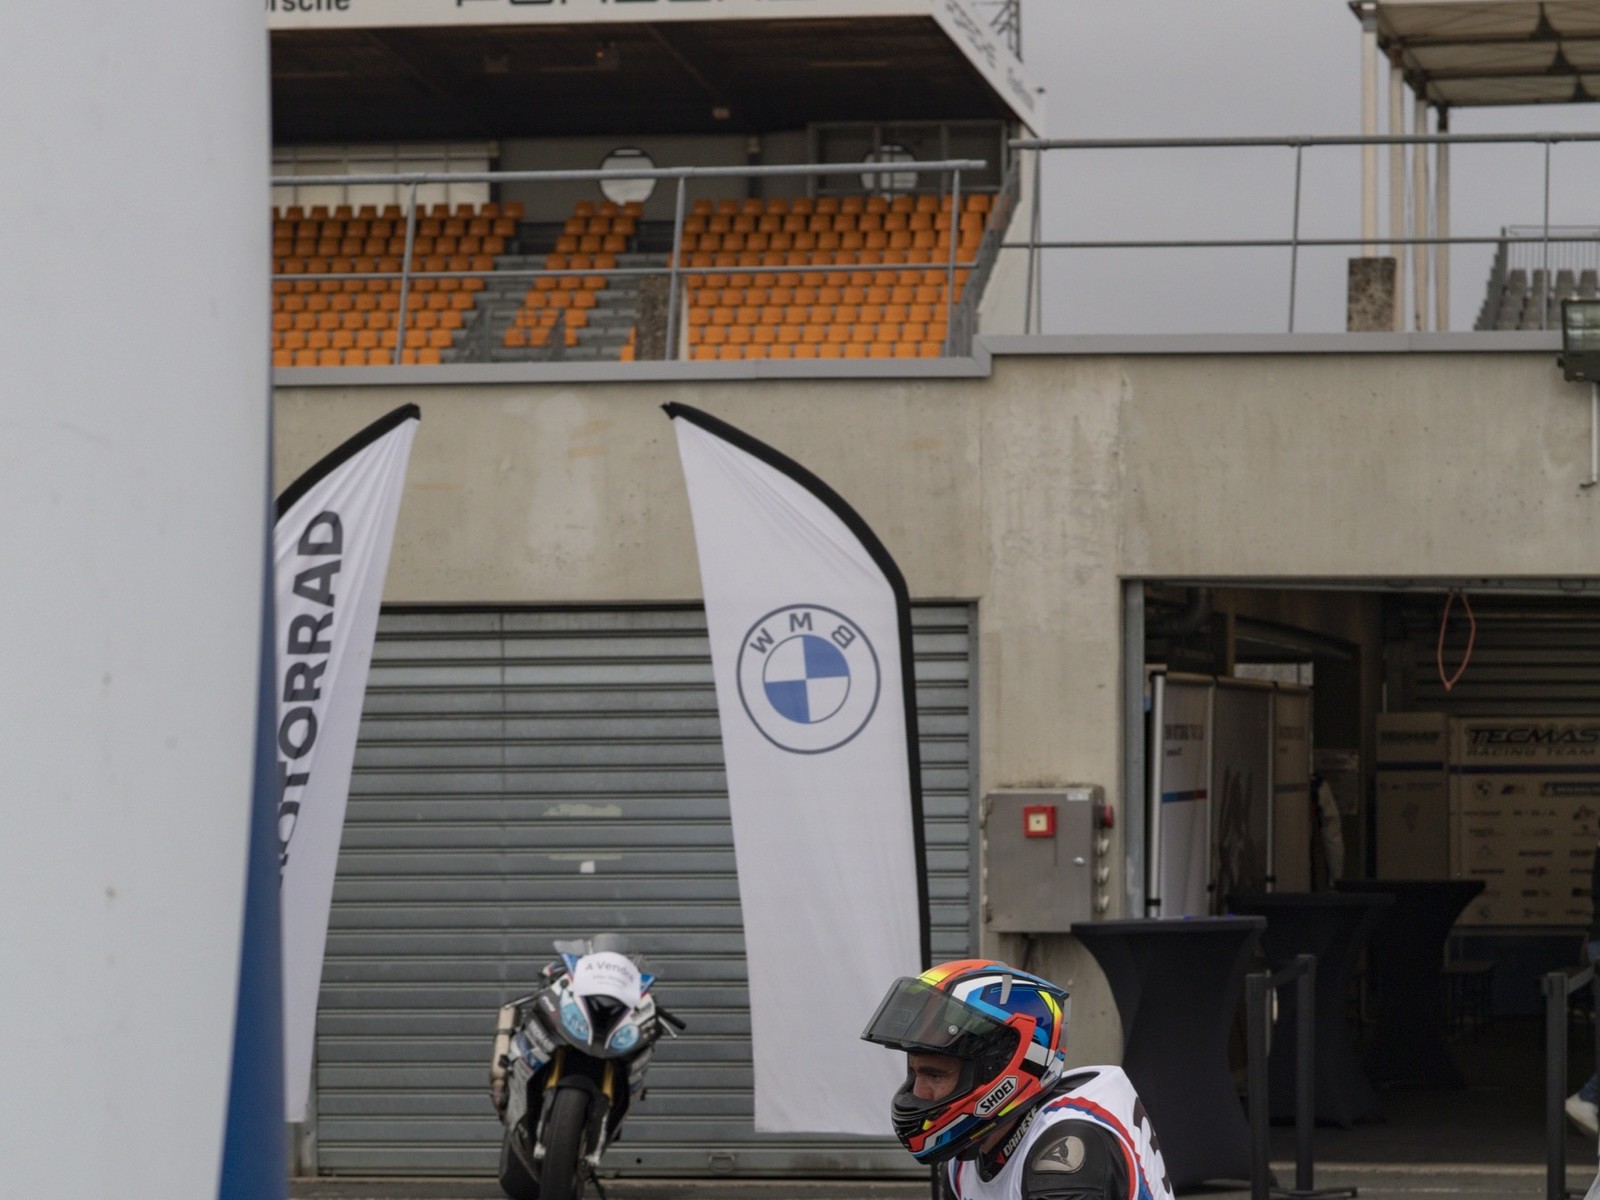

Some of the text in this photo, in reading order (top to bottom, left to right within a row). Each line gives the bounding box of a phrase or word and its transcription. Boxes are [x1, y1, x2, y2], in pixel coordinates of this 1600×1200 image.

[278, 510, 343, 888] OTORRAD
[1467, 726, 1600, 745] TECMAS
[980, 1080, 1014, 1113] SHOEI
[1002, 1105, 1037, 1157] DAINESE
